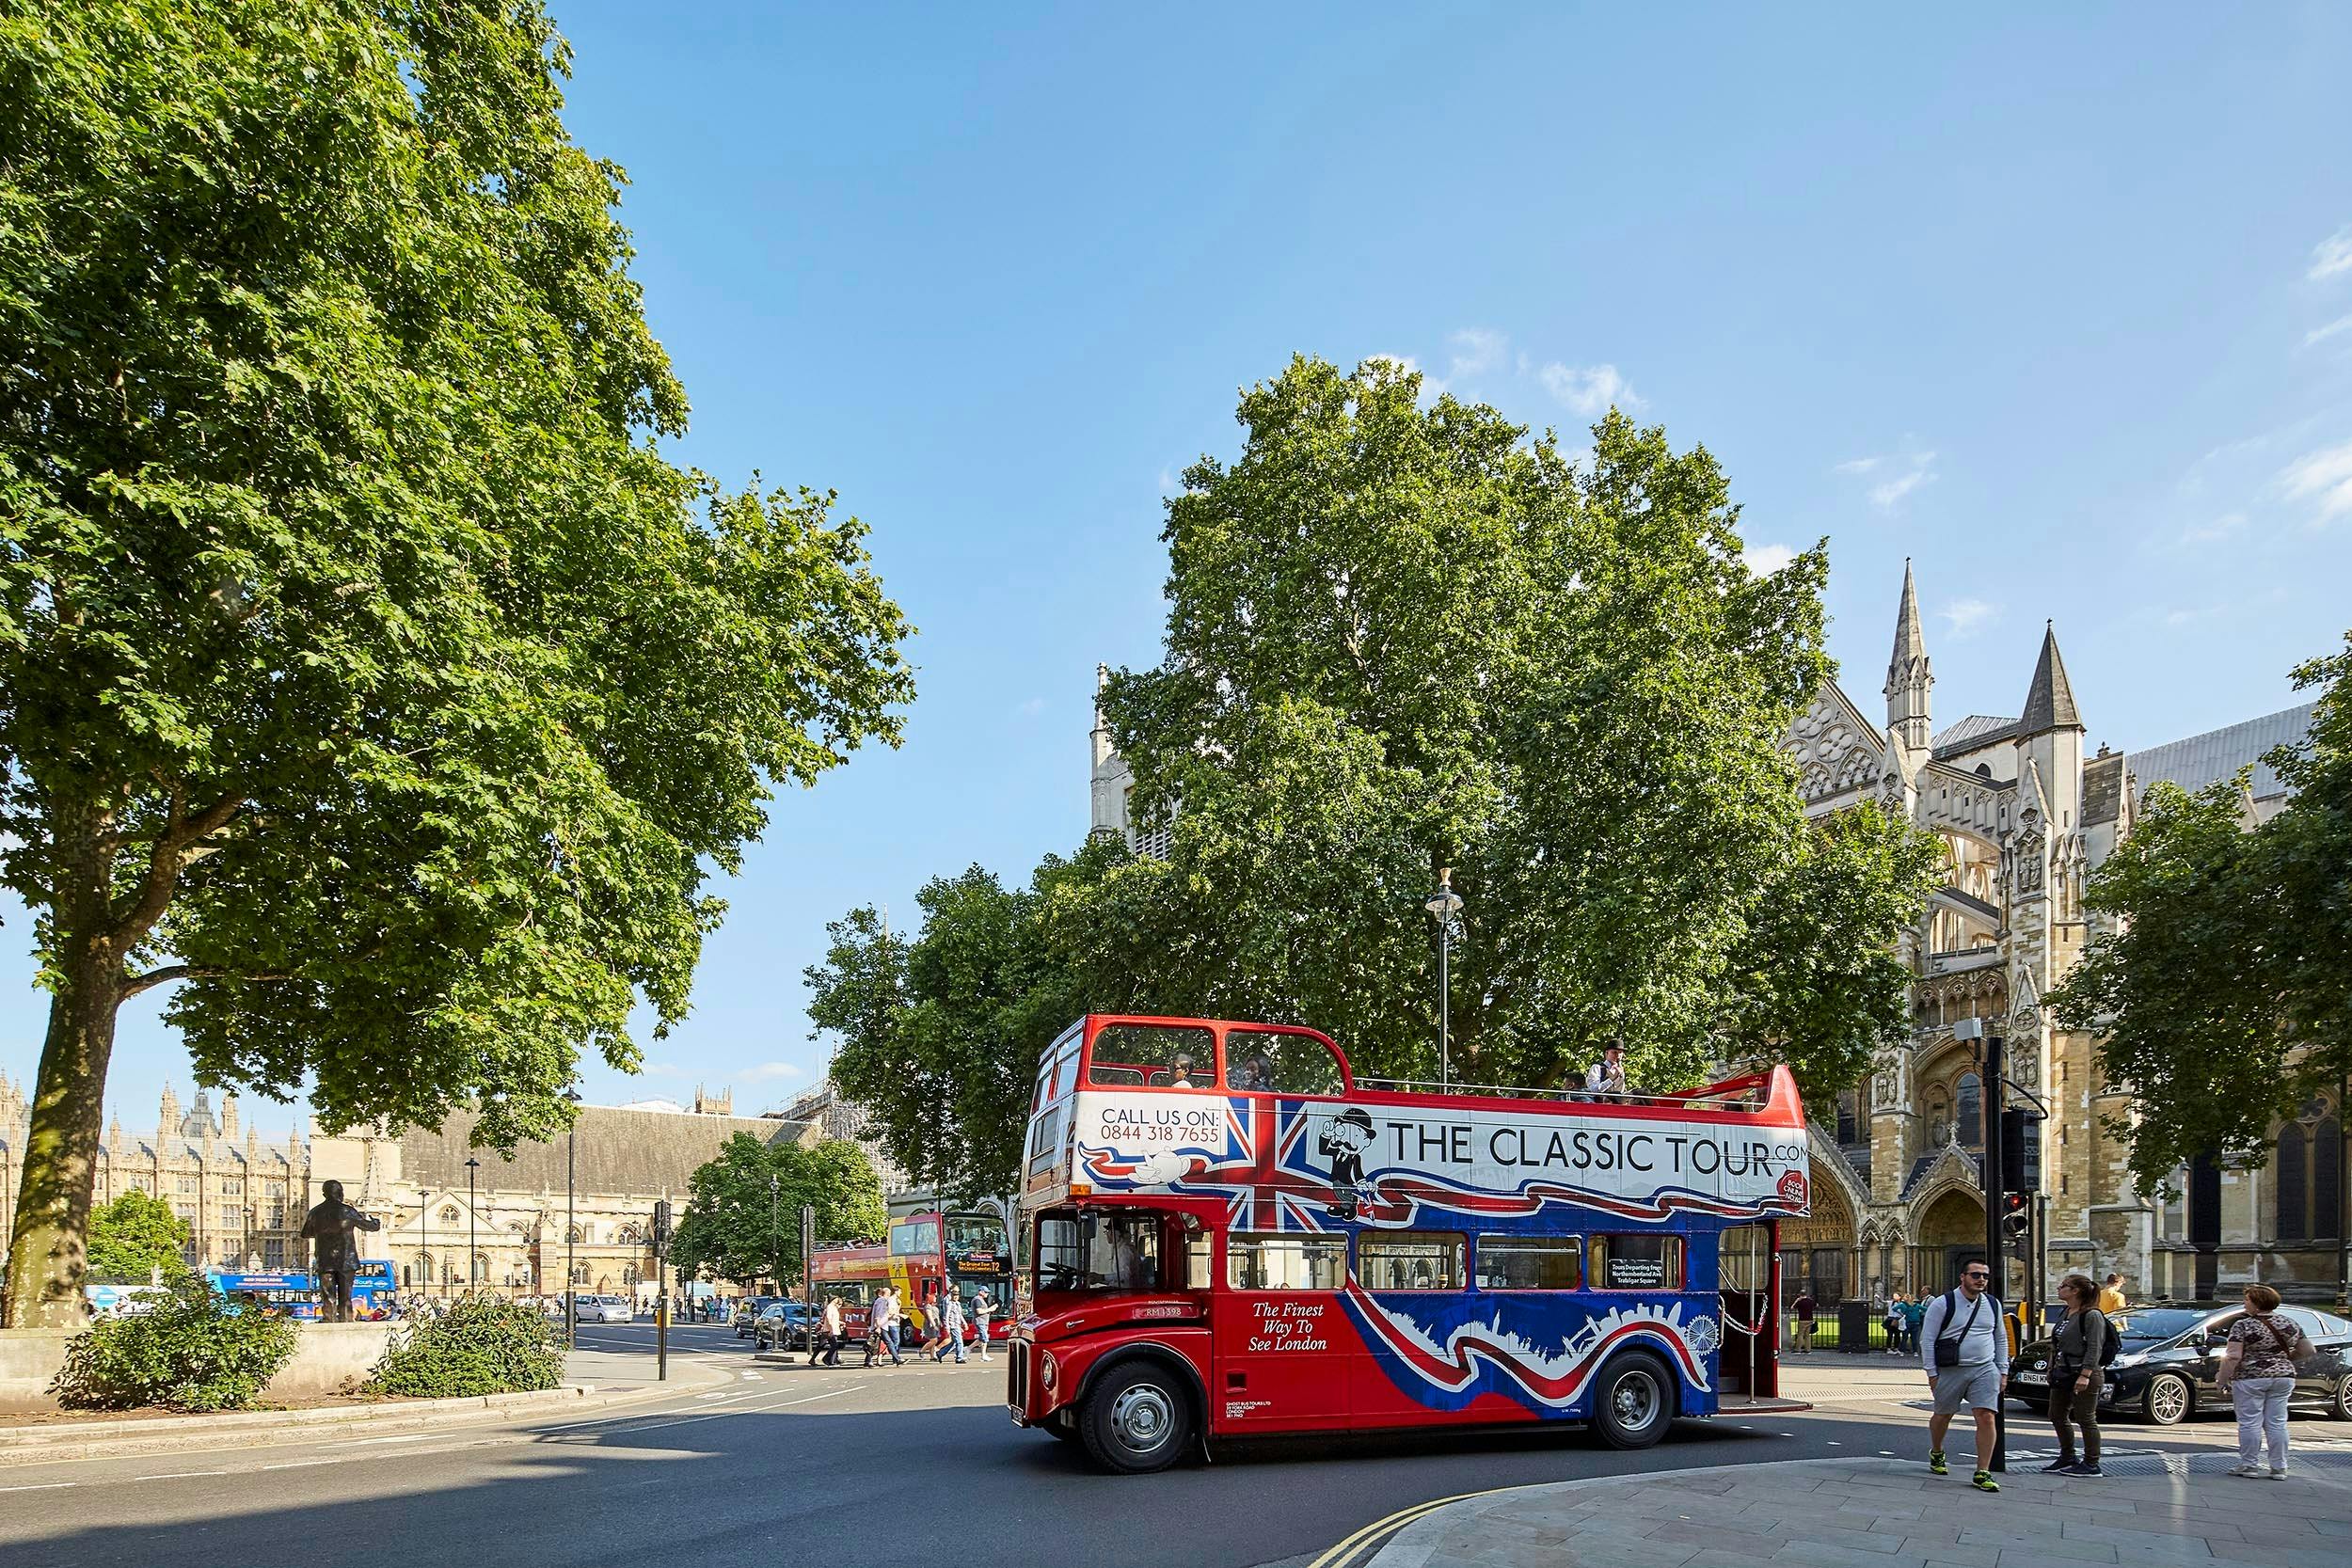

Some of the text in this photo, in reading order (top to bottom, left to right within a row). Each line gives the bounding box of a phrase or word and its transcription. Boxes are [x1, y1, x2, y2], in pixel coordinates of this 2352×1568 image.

[1102, 1108, 1219, 1127] CALL US ON:
[1101, 1125, 1218, 1143] 0844 318 7655
[1387, 1122, 1473, 1164] THE
[1489, 1128, 1653, 1171] CLASSIC
[992, 1261, 1000, 1272] T2
[1252, 1302, 1324, 1317] The Finest
[1263, 1319, 1313, 1338] Way To
[1248, 1336, 1327, 1351] See London
[2023, 1374, 2039, 1382] BN61
